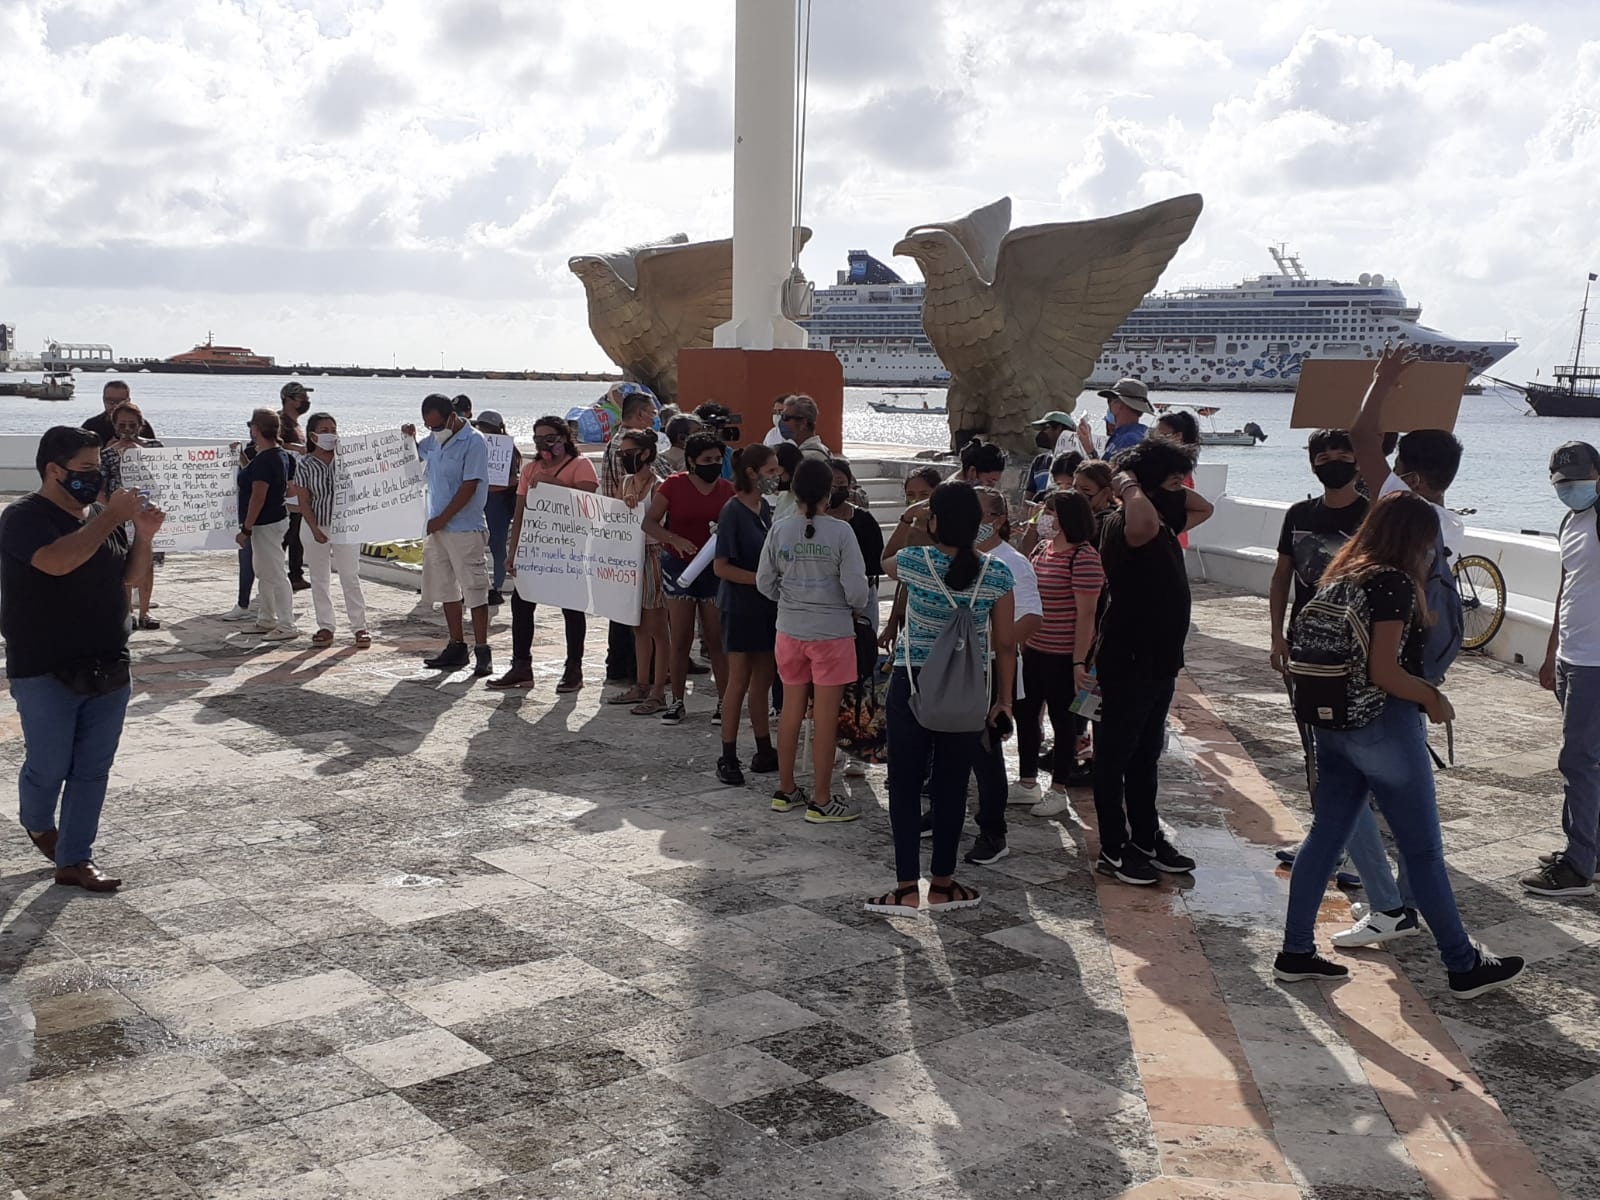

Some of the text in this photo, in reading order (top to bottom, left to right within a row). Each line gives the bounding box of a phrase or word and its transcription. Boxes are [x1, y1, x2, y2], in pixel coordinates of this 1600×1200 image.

[336, 435, 368, 456] Cozumel
[173, 447, 183, 461] de
[380, 460, 389, 473] NO
[163, 473, 179, 484] que
[184, 480, 208, 490] Planta
[335, 491, 347, 506] El
[163, 501, 180, 512] San
[183, 500, 218, 512] Miguelito
[525, 492, 640, 525] Cozumel NO Necesita
[331, 522, 360, 535] blanco
[523, 516, 633, 542] más muelles, tenemos
[516, 545, 528, 558] El
[541, 549, 567, 560] muelle
[607, 557, 638, 568] especies
[566, 562, 584, 580] bajo
[596, 567, 637, 587] NOM-059
